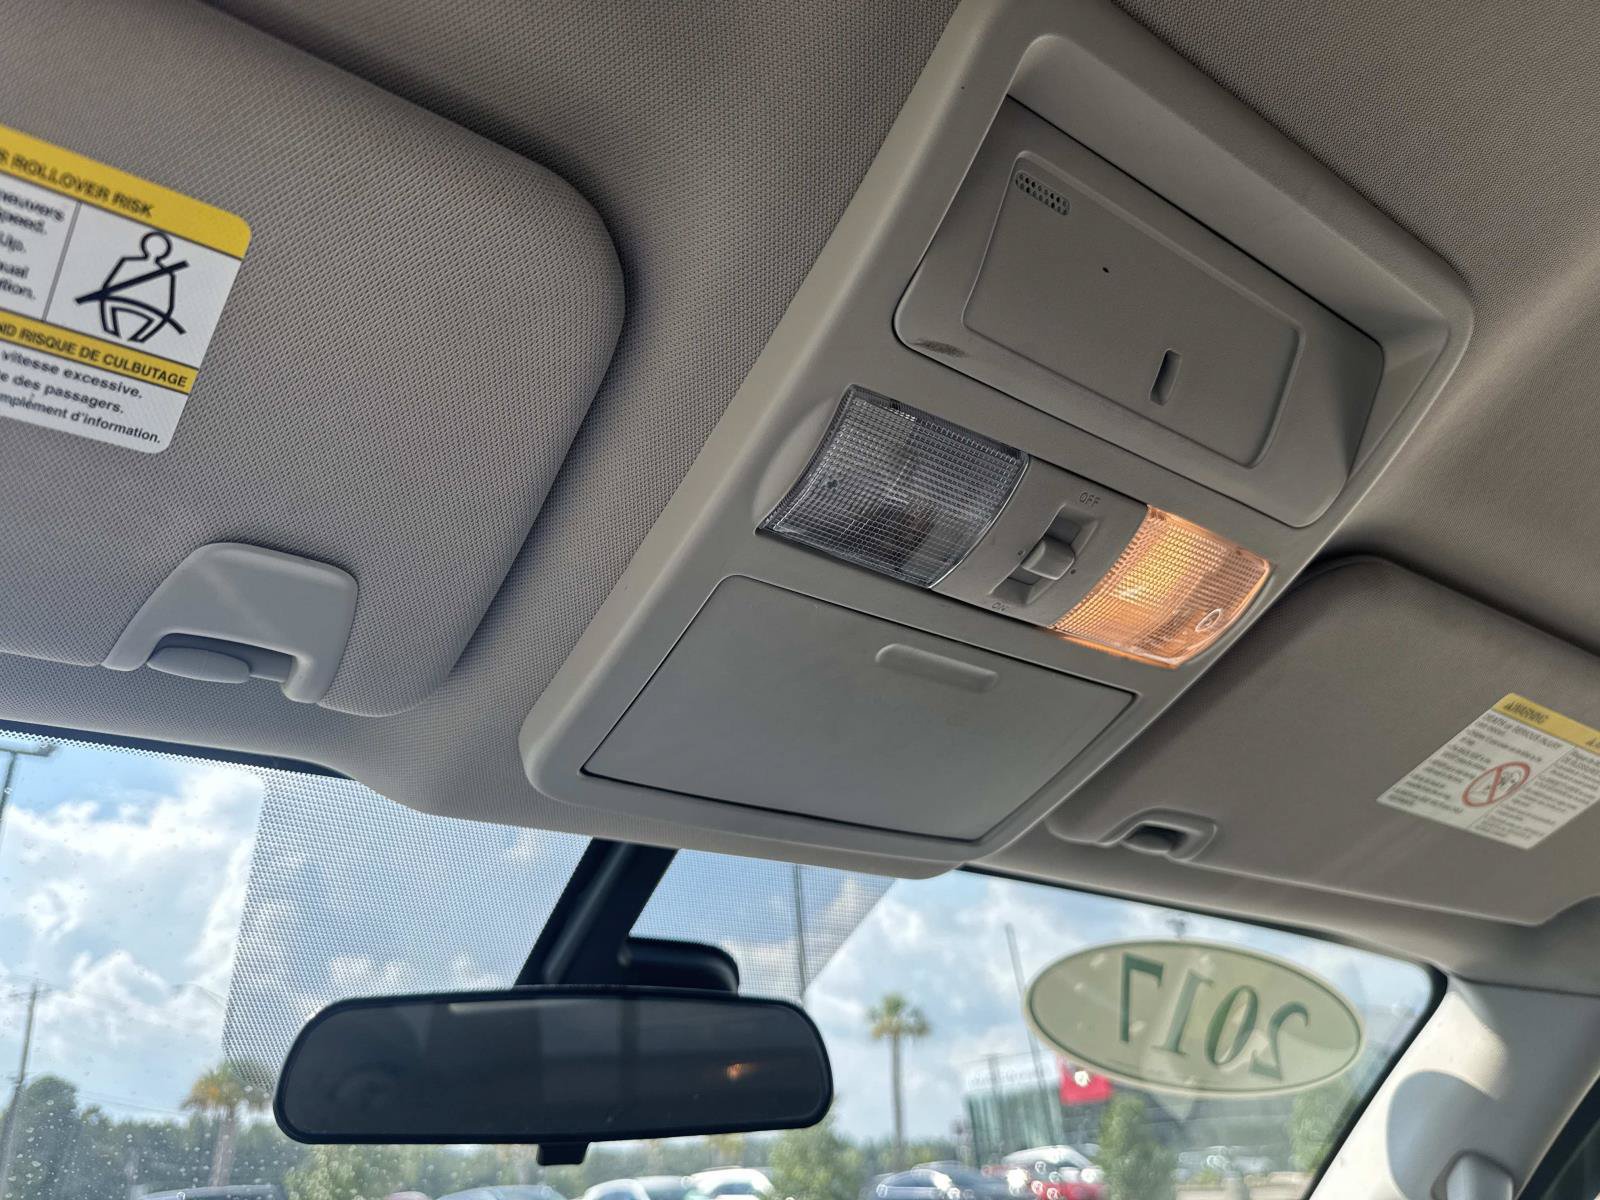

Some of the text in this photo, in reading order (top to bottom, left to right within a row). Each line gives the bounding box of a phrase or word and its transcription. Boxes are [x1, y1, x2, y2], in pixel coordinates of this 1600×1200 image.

[10, 152, 112, 200] ROLLOVER
[111, 186, 155, 218] RISK
[1, 350, 144, 399] vitesse excessive.
[19, 327, 78, 354] RISQUE
[79, 346, 101, 363] DE
[102, 352, 188, 388] CULBUTAGE
[12, 375, 41, 391] des
[43, 384, 125, 414] passagers.
[70, 410, 161, 444] d'information.
[1079, 491, 1101, 506] OFF
